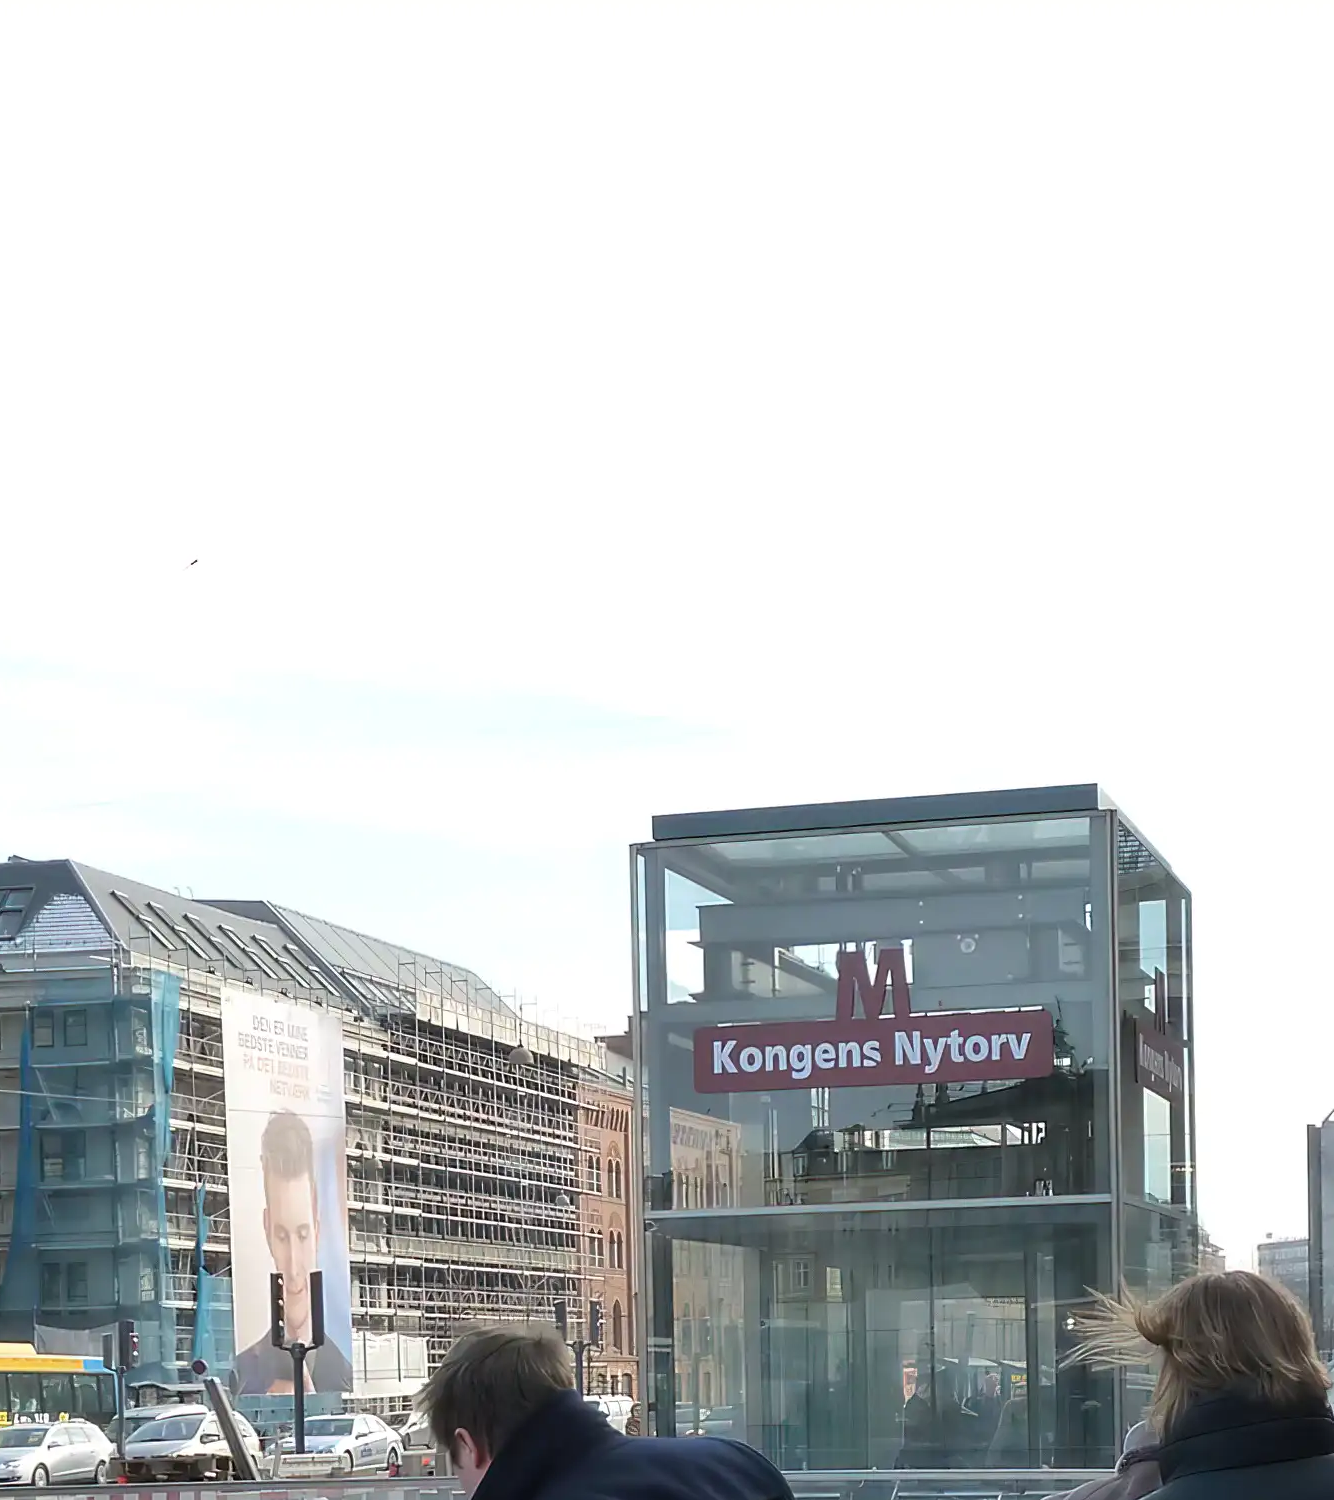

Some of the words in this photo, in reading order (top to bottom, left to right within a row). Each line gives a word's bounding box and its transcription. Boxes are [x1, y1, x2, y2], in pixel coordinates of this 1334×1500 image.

[836, 948, 912, 1021] M
[713, 1039, 881, 1080] Kongens
[894, 1029, 1031, 1073] Nytorv
